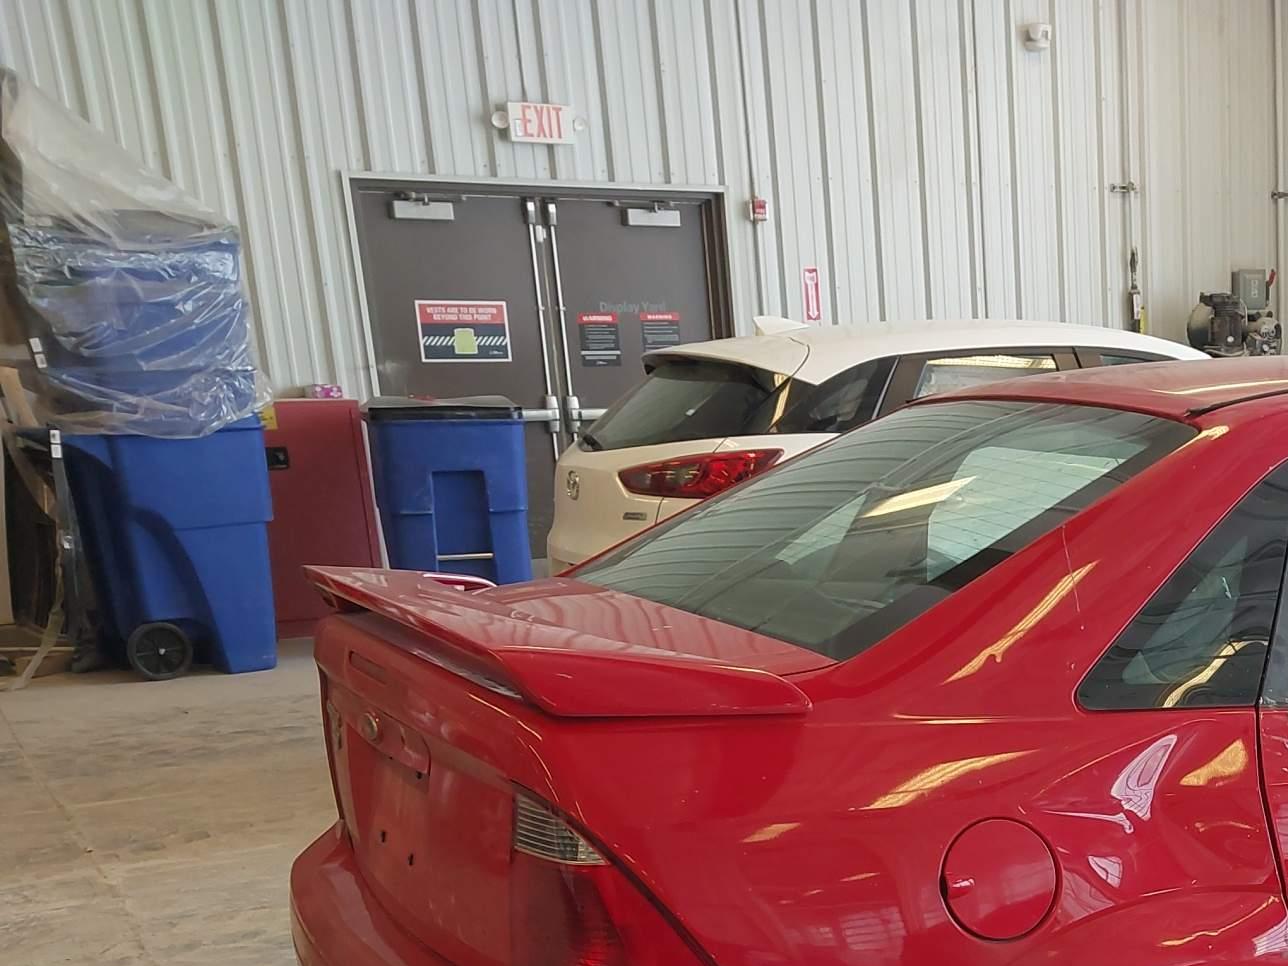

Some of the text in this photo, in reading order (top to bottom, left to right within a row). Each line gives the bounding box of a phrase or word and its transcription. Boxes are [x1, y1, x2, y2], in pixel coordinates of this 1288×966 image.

[521, 105, 562, 139] EXIT
[600, 301, 666, 314] Display Yard
